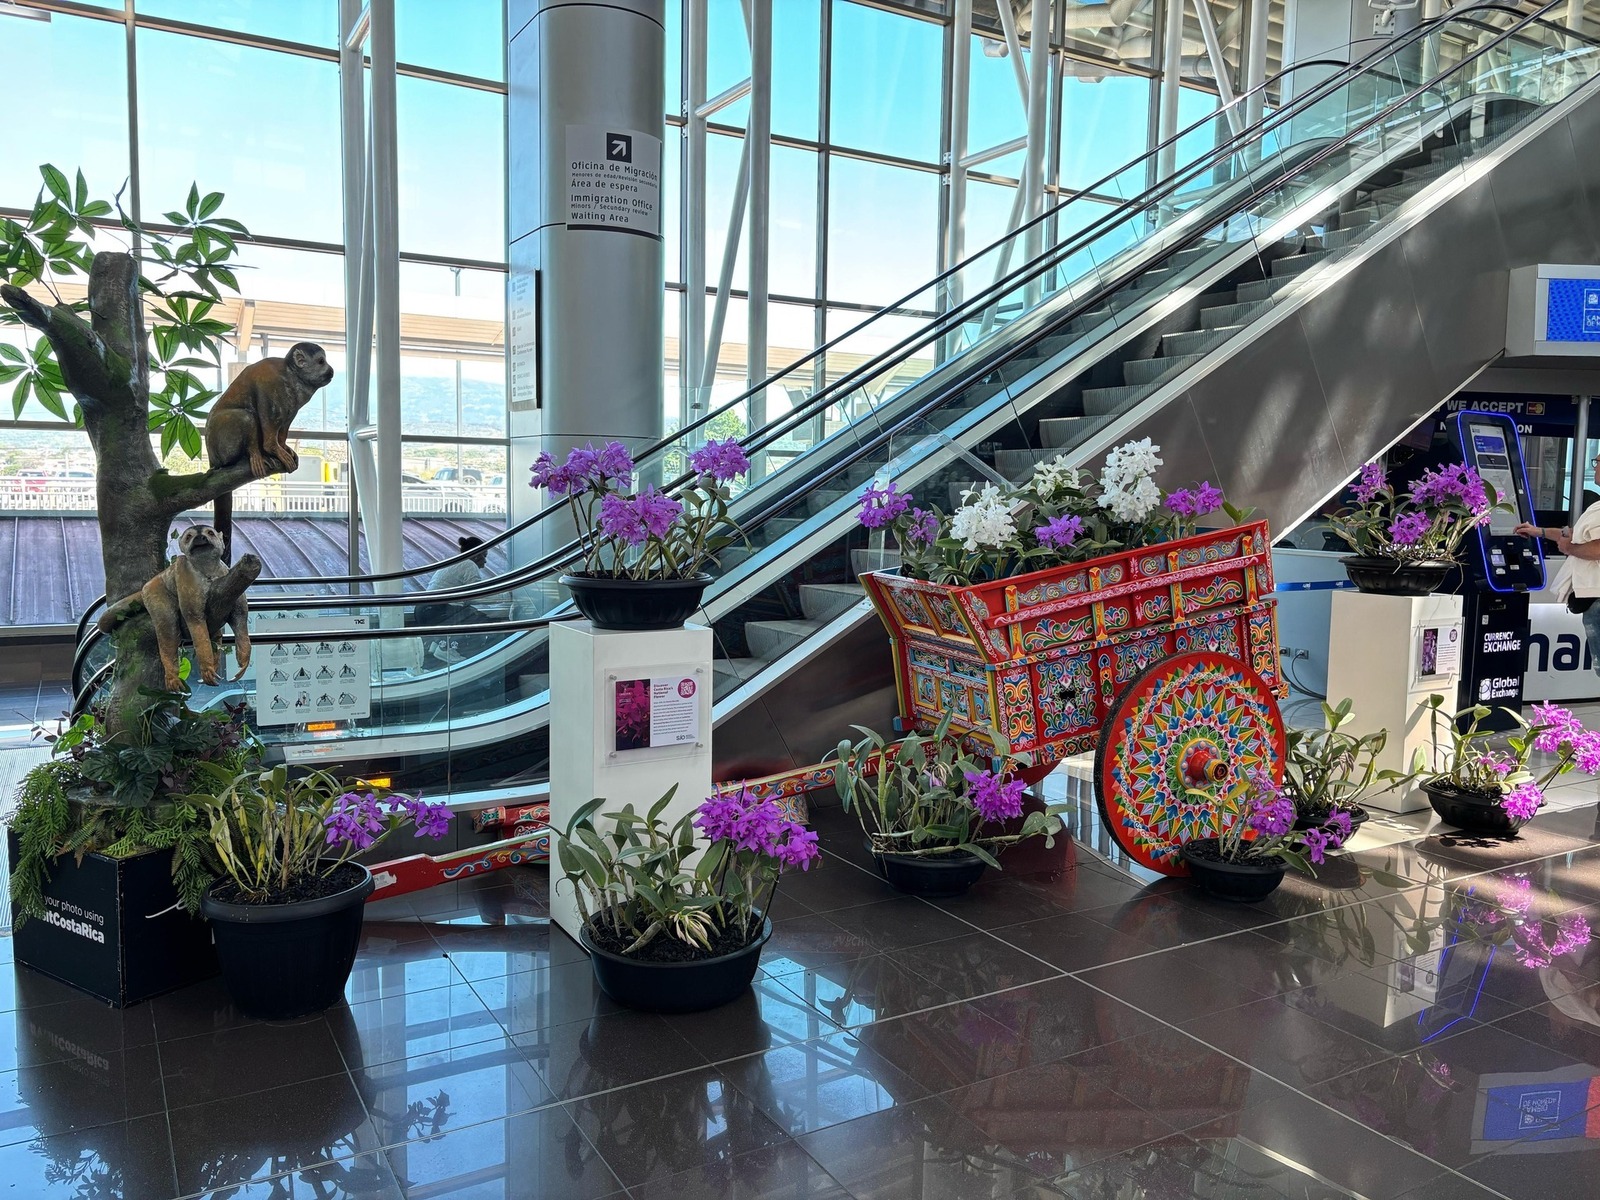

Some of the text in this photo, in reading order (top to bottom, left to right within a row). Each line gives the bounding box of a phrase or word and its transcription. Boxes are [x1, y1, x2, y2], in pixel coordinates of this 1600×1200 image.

[571, 161, 658, 181] Oficina de Migración
[571, 179, 638, 192] Área de espera
[571, 194, 653, 211] Immigration Office
[571, 212, 629, 223] Waiting Area
[1446, 400, 1467, 411] WE
[1470, 401, 1524, 413] ACCEPT
[1484, 631, 1514, 642] CURRENCY
[1483, 639, 1521, 653] EXCHANGE
[1492, 676, 1520, 689] Global
[1491, 688, 1519, 698] Exchange
[44, 895, 104, 926] your photo using
